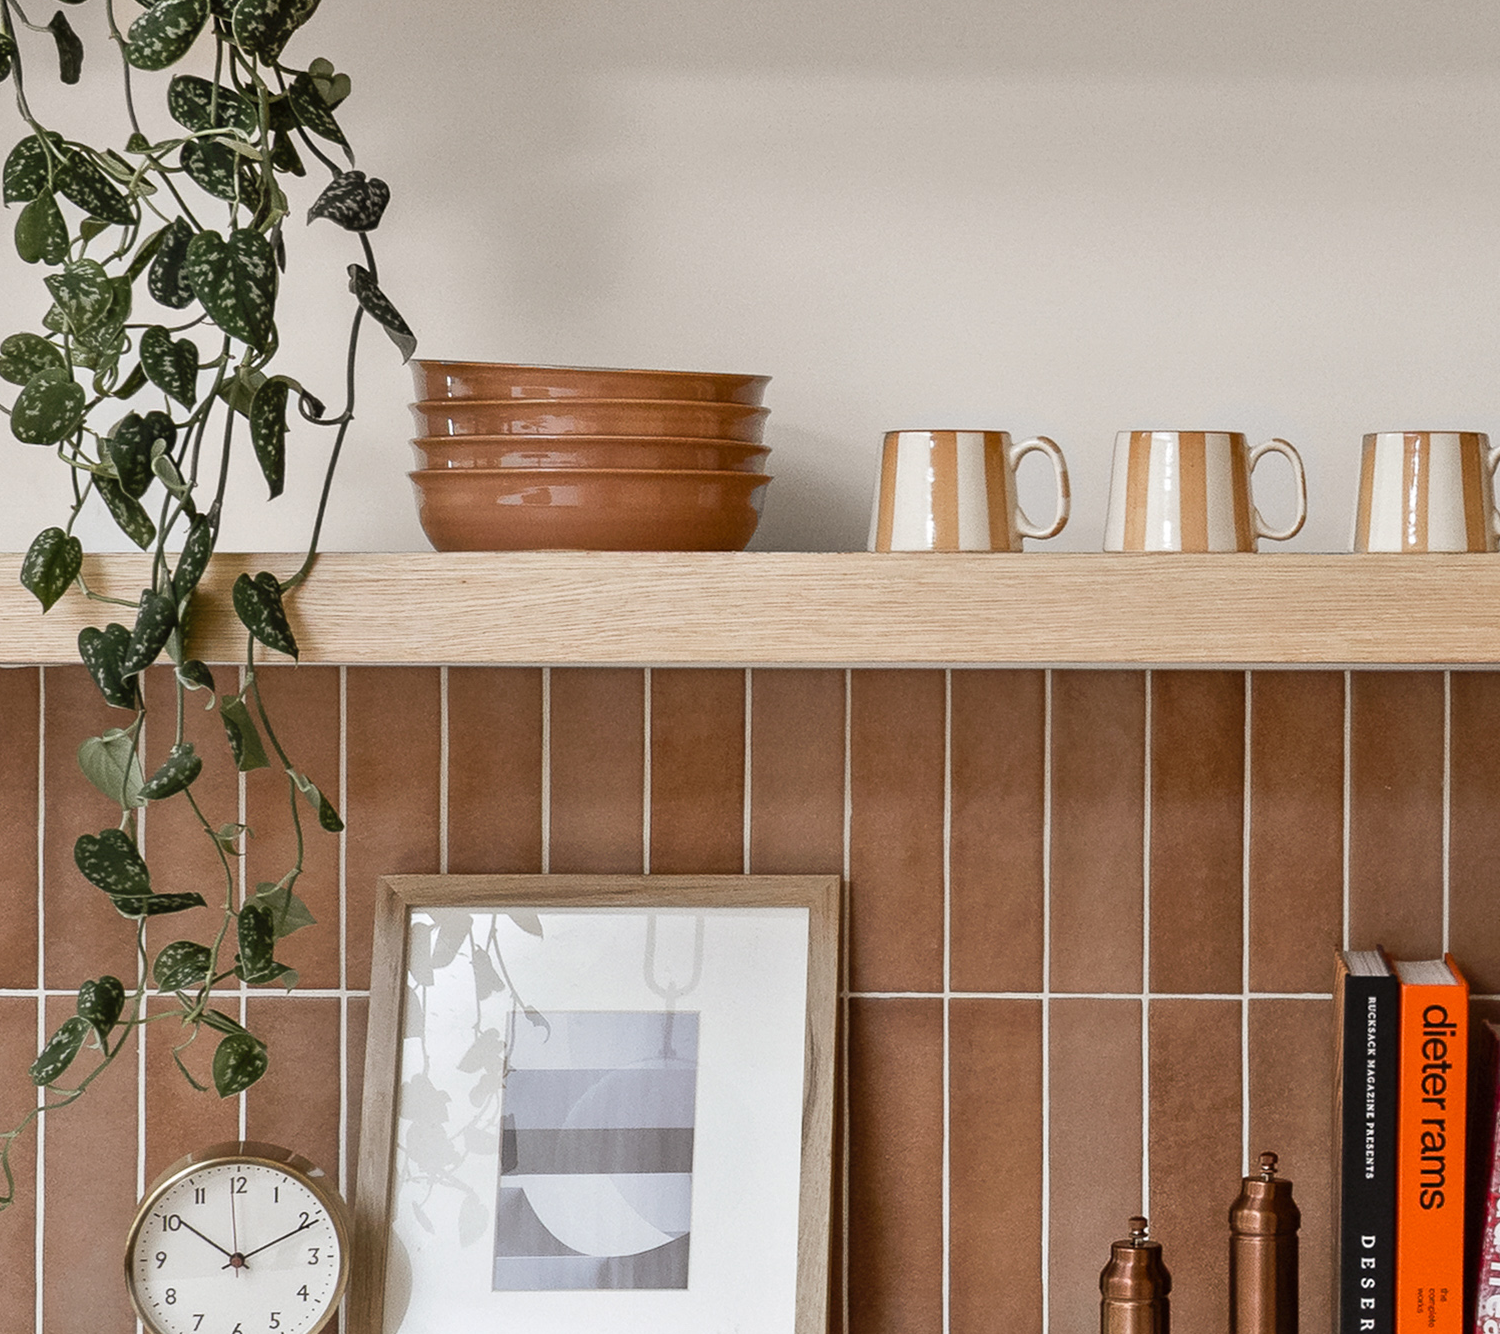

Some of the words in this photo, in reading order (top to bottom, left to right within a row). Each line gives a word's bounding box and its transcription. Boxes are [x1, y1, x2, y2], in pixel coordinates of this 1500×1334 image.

[1367, 996, 1377, 1056] RUCKSACK
[1421, 1004, 1457, 1110] dieter
[1366, 1059, 1376, 1118] MAGAZINE
[1365, 1122, 1375, 1179] PRESENTS
[1419, 1119, 1446, 1210] rams
[230, 1176, 247, 1194] 12
[195, 1187, 206, 1204] 11
[274, 1186, 279, 1203] 1
[162, 1214, 182, 1232] 10
[299, 1212, 311, 1229] 2
[155, 1251, 167, 1269] 9
[307, 1248, 320, 1265] 3
[165, 1288, 177, 1305] 8
[296, 1285, 310, 1301] 4
[1428, 1288, 1436, 1328] complete
[193, 1314, 205, 1331] 7
[269, 1312, 281, 1329] 5
